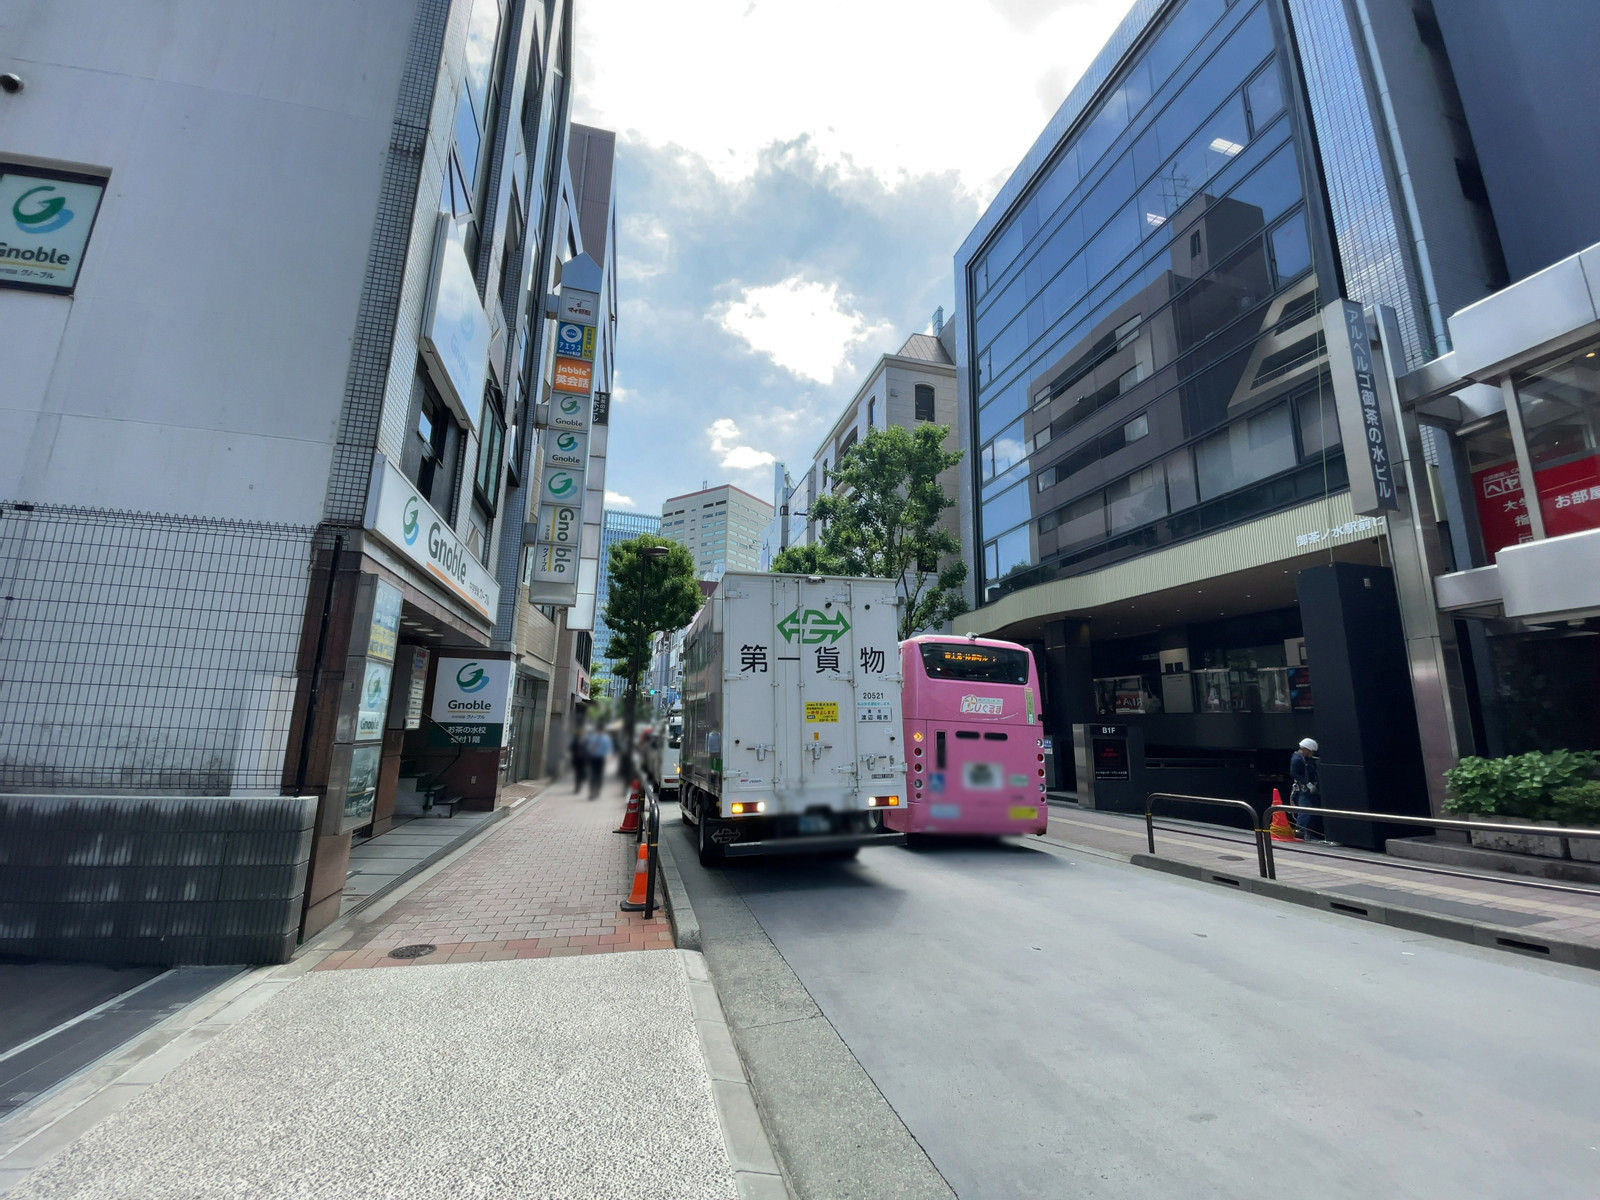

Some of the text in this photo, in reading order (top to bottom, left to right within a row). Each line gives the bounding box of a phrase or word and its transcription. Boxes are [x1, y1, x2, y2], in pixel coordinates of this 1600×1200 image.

[555, 374, 590, 389] 英会話
[555, 417, 583, 427] Gnoble
[552, 454, 581, 464] Gnoble
[428, 521, 467, 585] Gnoble
[740, 644, 885, 674] 第一貨物
[862, 692, 884, 700] 20521
[447, 699, 492, 710] Gnoble
[448, 726, 487, 734] お茶の水校
[1102, 726, 1116, 734] B1F
